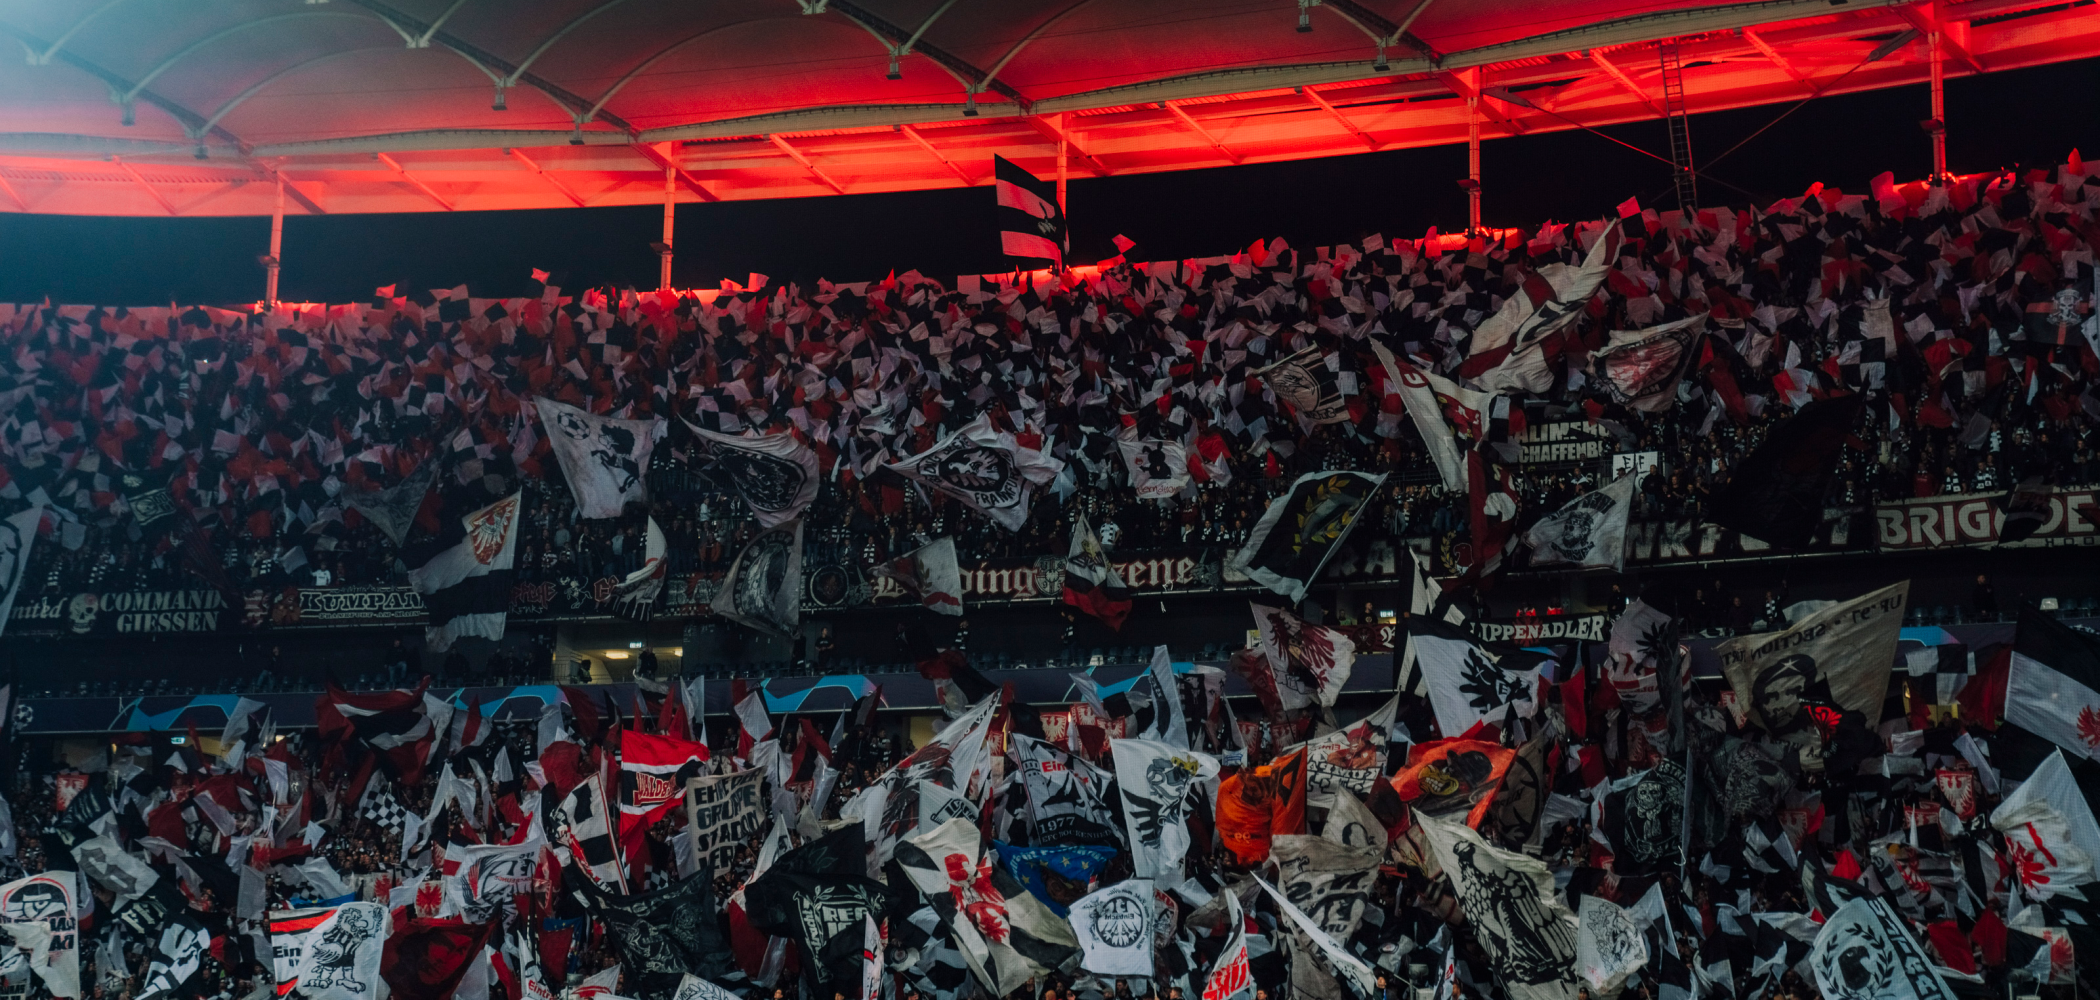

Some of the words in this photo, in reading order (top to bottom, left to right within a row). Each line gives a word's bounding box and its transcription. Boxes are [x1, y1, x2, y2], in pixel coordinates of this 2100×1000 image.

[9, 596, 68, 620] nited
[116, 611, 221, 633] GIESSEN
[1039, 816, 1076, 834] 1977
